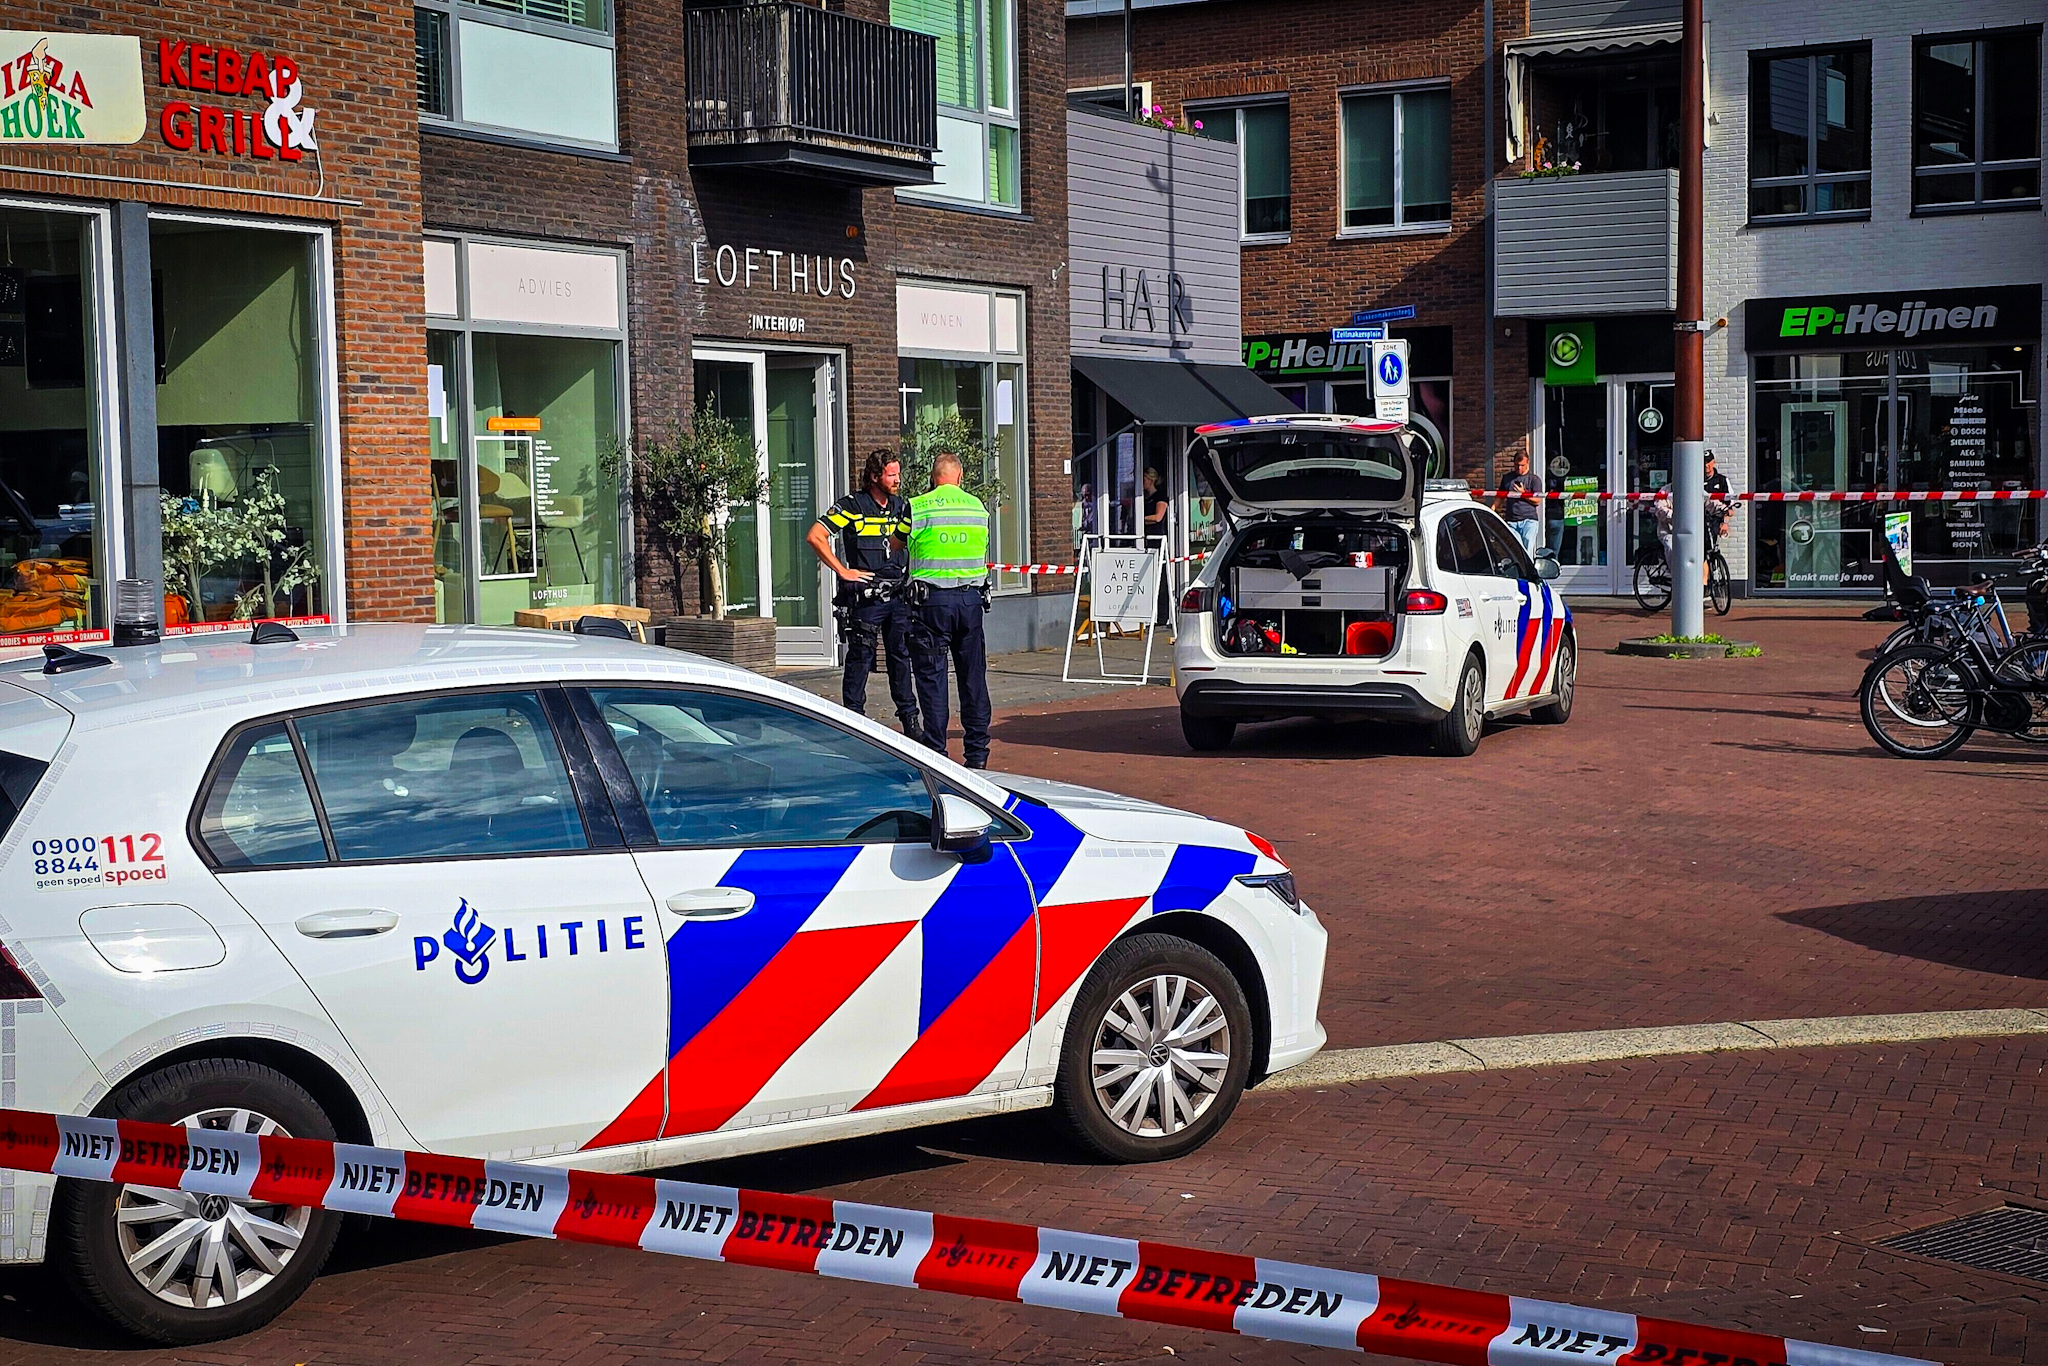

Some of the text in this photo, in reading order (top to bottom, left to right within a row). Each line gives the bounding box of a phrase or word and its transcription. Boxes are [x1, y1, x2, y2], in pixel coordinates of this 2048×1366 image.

[159, 38, 298, 98] KEBAP
[0, 93, 85, 138] HOEK
[160, 101, 302, 161] GRILL
[691, 242, 856, 299] LOFTHUS
[519, 278, 572, 297] ADVIES
[921, 313, 963, 327] WONEN
[1779, 301, 1998, 338] EP:Heijnen
[940, 533, 967, 543] OvD
[1115, 560, 1136, 568] WE
[1110, 573, 1140, 582] ARE
[1790, 572, 1817, 581] denkt
[1819, 573, 1839, 581] met
[1840, 573, 1851, 582] je
[533, 588, 568, 600] LOFTHUS
[1104, 585, 1145, 595] OPEN
[27, 635, 47, 644] WRAPS
[53, 634, 73, 642] SNACKS
[32, 837, 96, 855] 0900
[101, 833, 163, 863] 112
[34, 856, 99, 874] 8844
[105, 864, 167, 885] spoed
[36, 875, 101, 889] geen spoed
[414, 897, 645, 984] POLITIE
[65, 1132, 239, 1176] NIET BETREDEN
[340, 1162, 544, 1212] NIET BETREDEN
[659, 1200, 904, 1259] NIET BETREDEN
[1041, 1251, 1343, 1319] NIET BETREDEN
[1512, 1323, 1628, 1358] NIET
